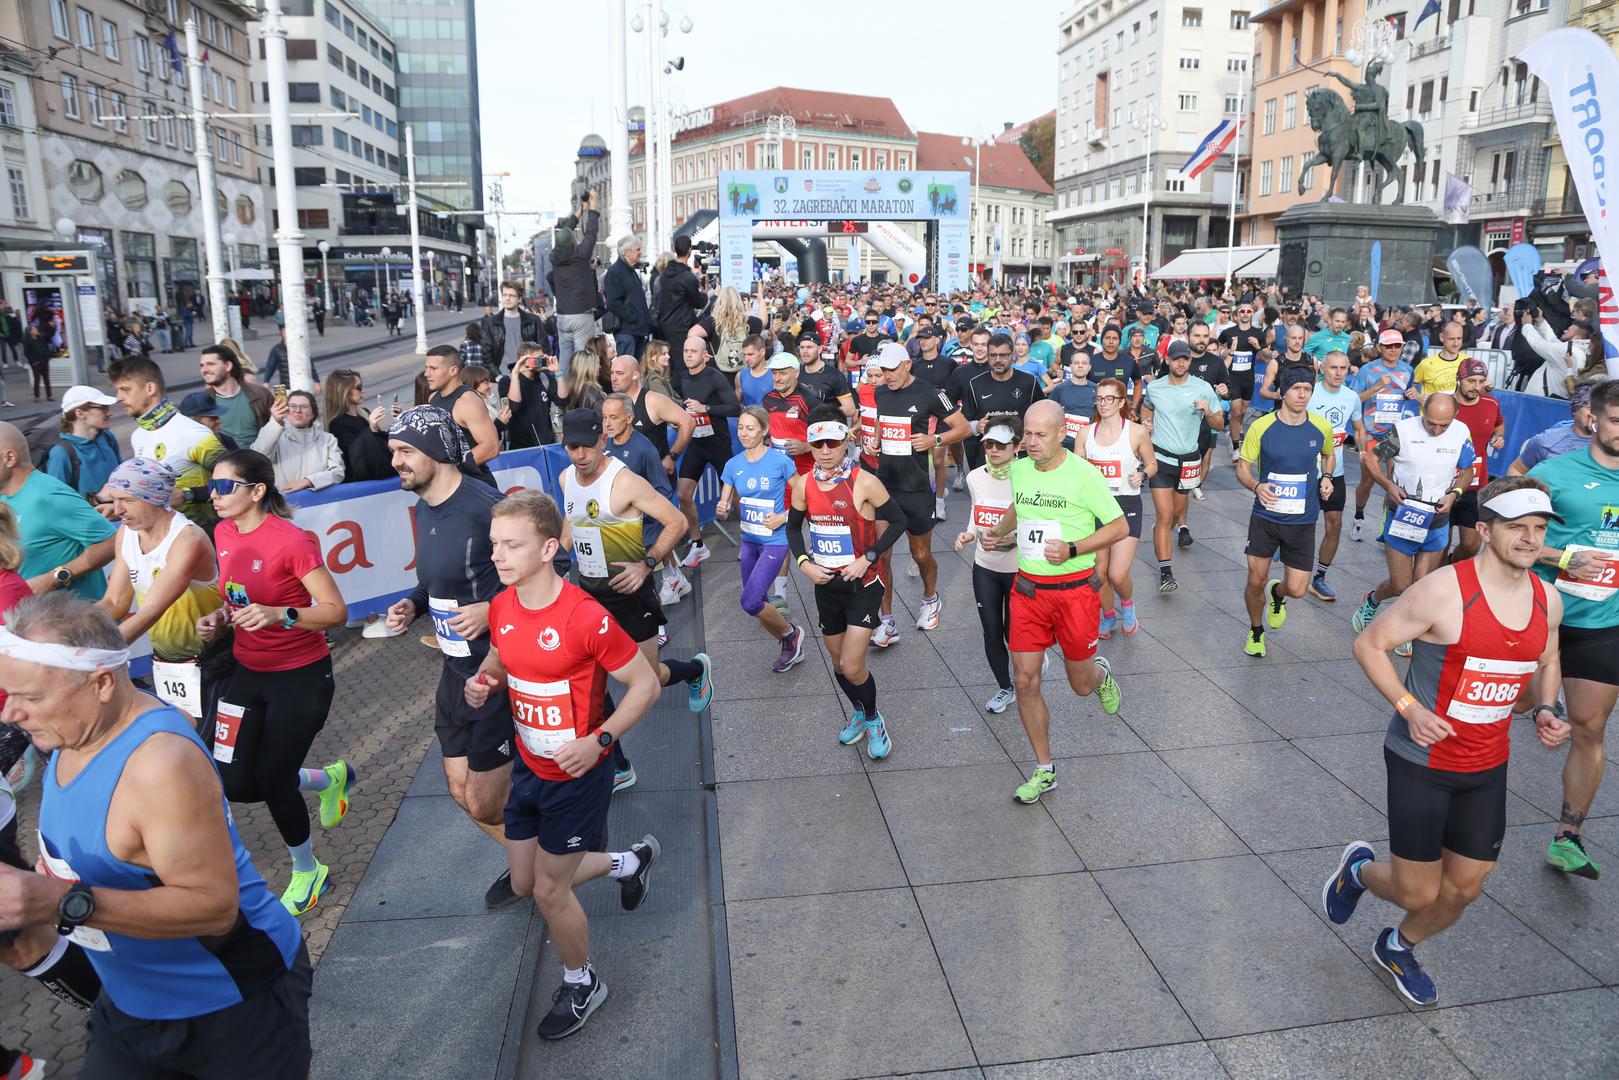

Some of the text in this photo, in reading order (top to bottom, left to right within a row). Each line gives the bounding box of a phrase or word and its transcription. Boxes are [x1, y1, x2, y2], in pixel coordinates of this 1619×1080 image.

[774, 195, 914, 214] 32. ZAGREBAČKI MARATON
[1382, 402, 1399, 412] 232
[882, 427, 906, 439] 3623
[1275, 486, 1298, 497] 840
[746, 510, 764, 522] 704
[1403, 510, 1426, 526] 256
[1028, 529, 1044, 544] 47
[817, 539, 842, 554] 905
[163, 680, 187, 698] 143
[1466, 681, 1521, 703] 3086
[515, 700, 562, 727] 3718
